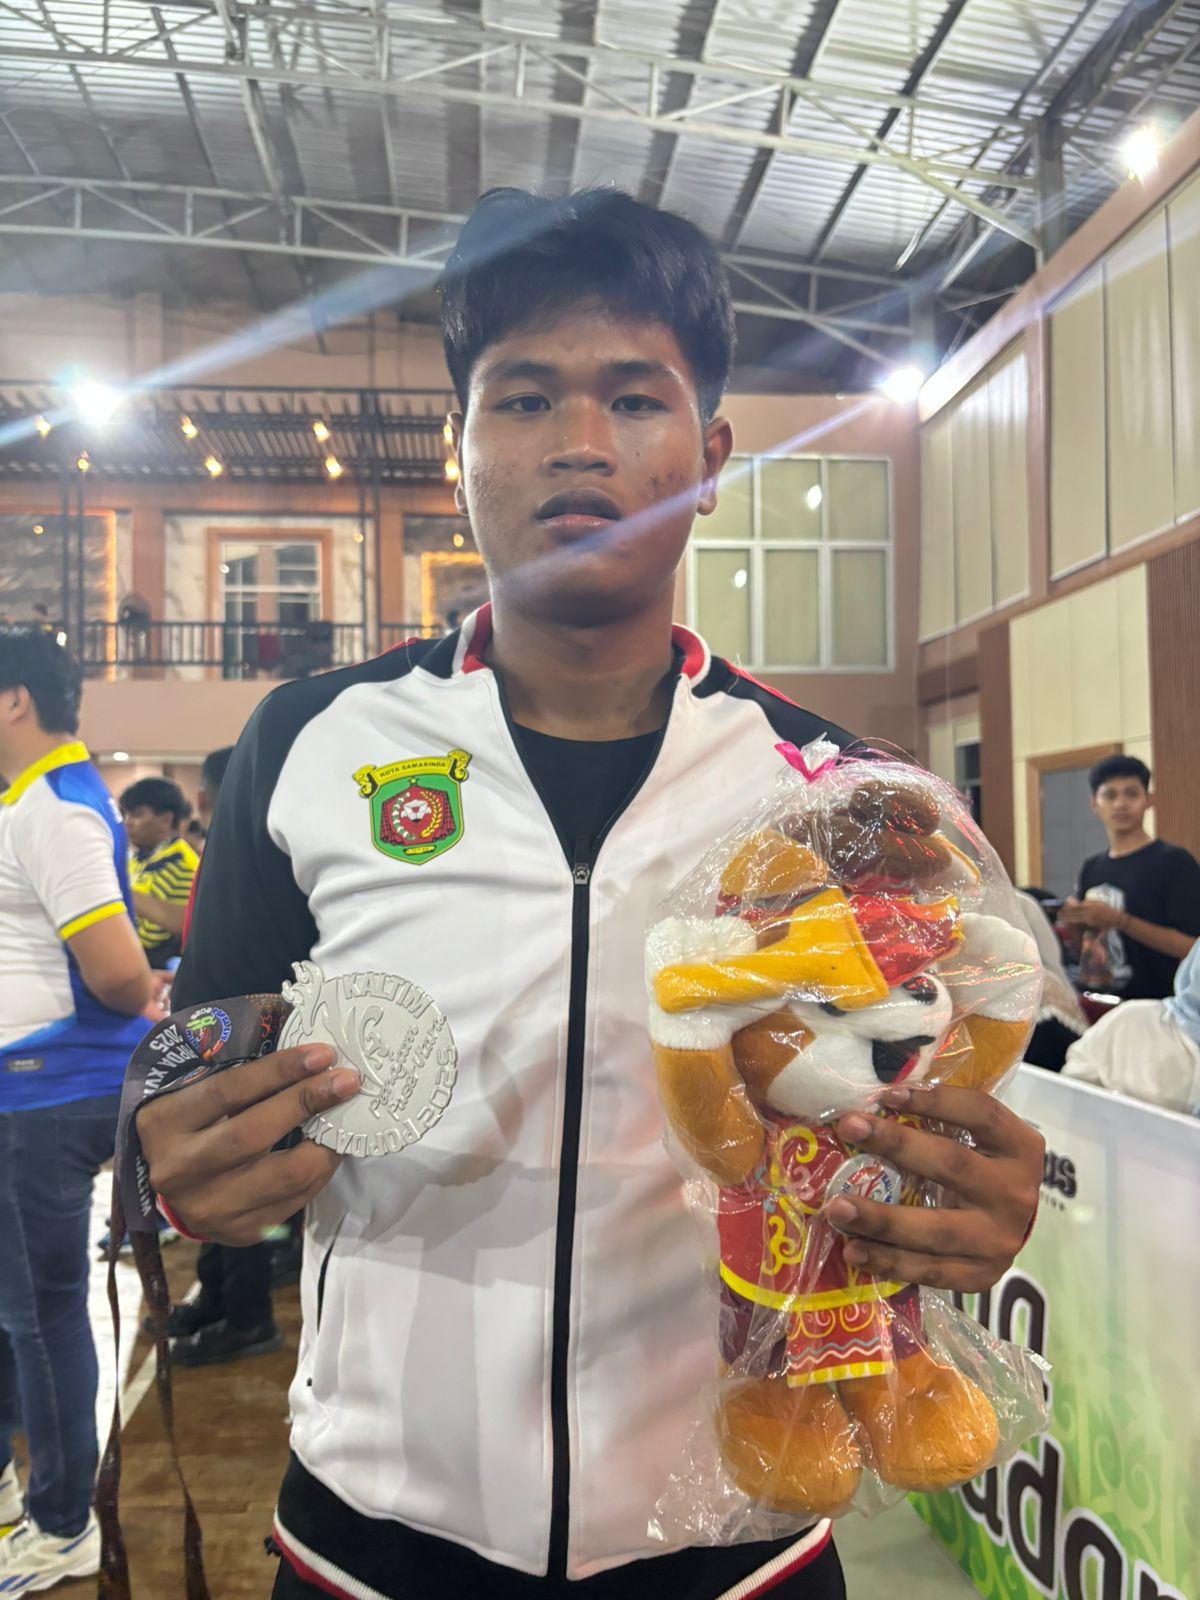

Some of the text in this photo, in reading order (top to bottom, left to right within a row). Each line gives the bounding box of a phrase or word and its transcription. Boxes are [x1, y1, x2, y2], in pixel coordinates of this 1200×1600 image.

[380, 766, 400, 778] KOTA
[344, 972, 435, 1019] KALTIM
[149, 1024, 183, 1053] 2025
[143, 1067, 169, 1099] XVI
[416, 1045, 459, 1129] 2025
[336, 1118, 422, 1158] POPDA
